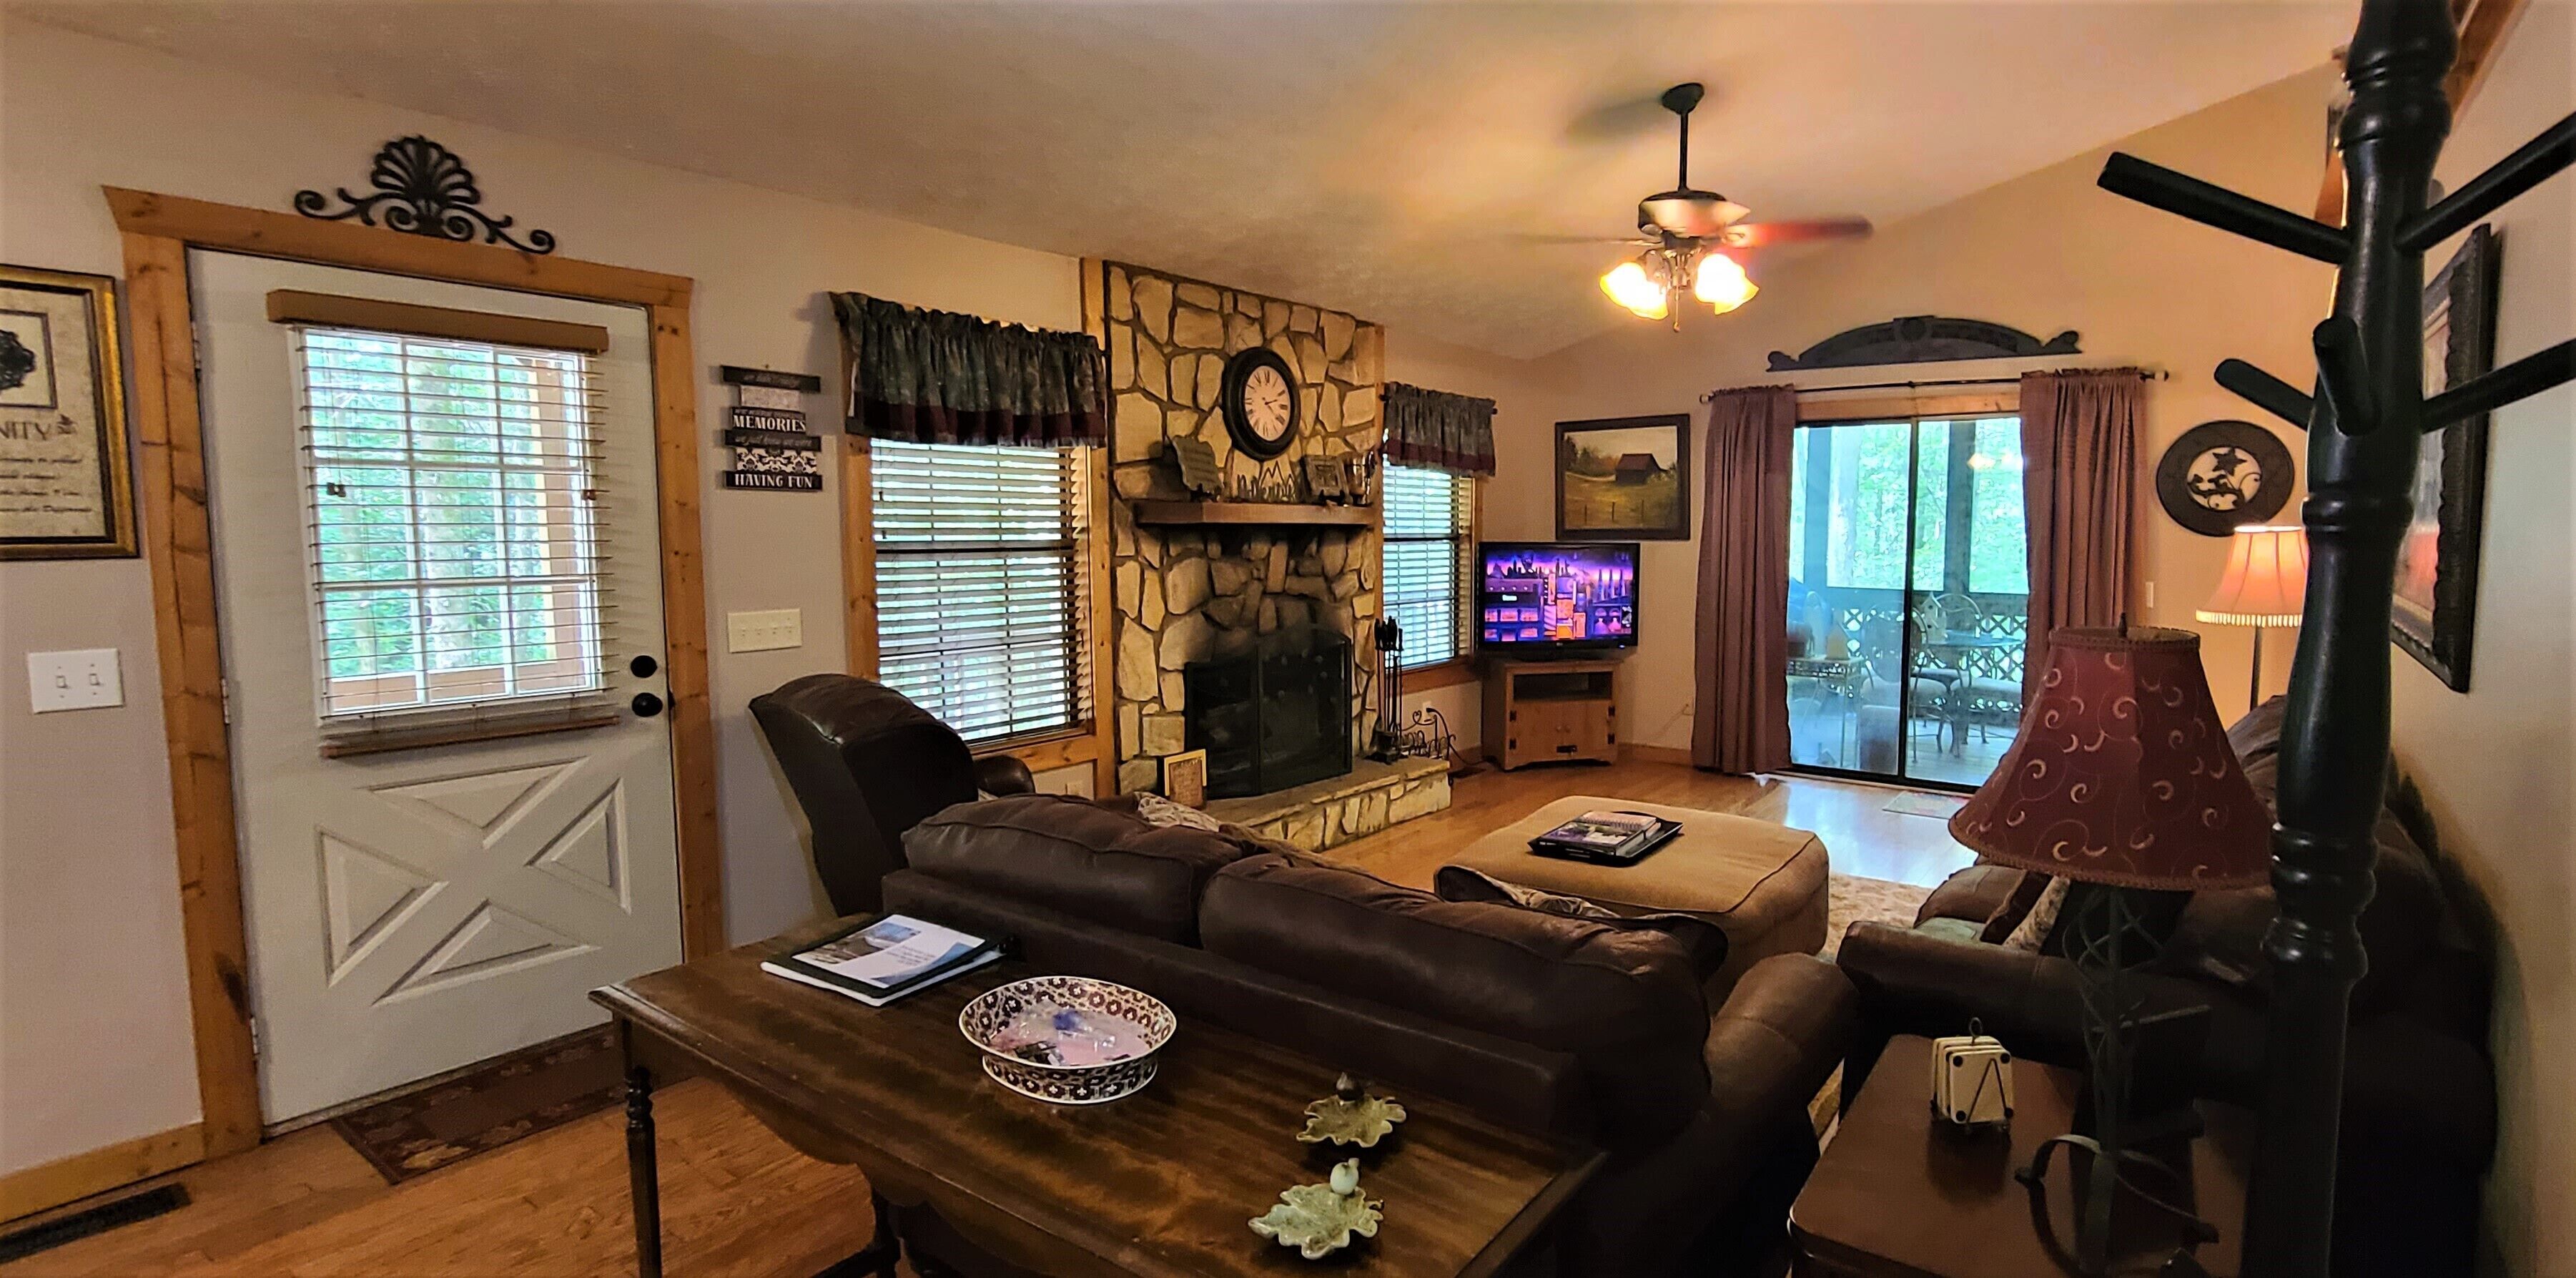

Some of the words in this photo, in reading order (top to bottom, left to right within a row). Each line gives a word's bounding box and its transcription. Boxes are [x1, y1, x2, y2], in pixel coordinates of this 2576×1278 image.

[733, 415, 806, 432] MEMORIES
[734, 473, 784, 487] HAVING
[788, 475, 813, 488] FUN
